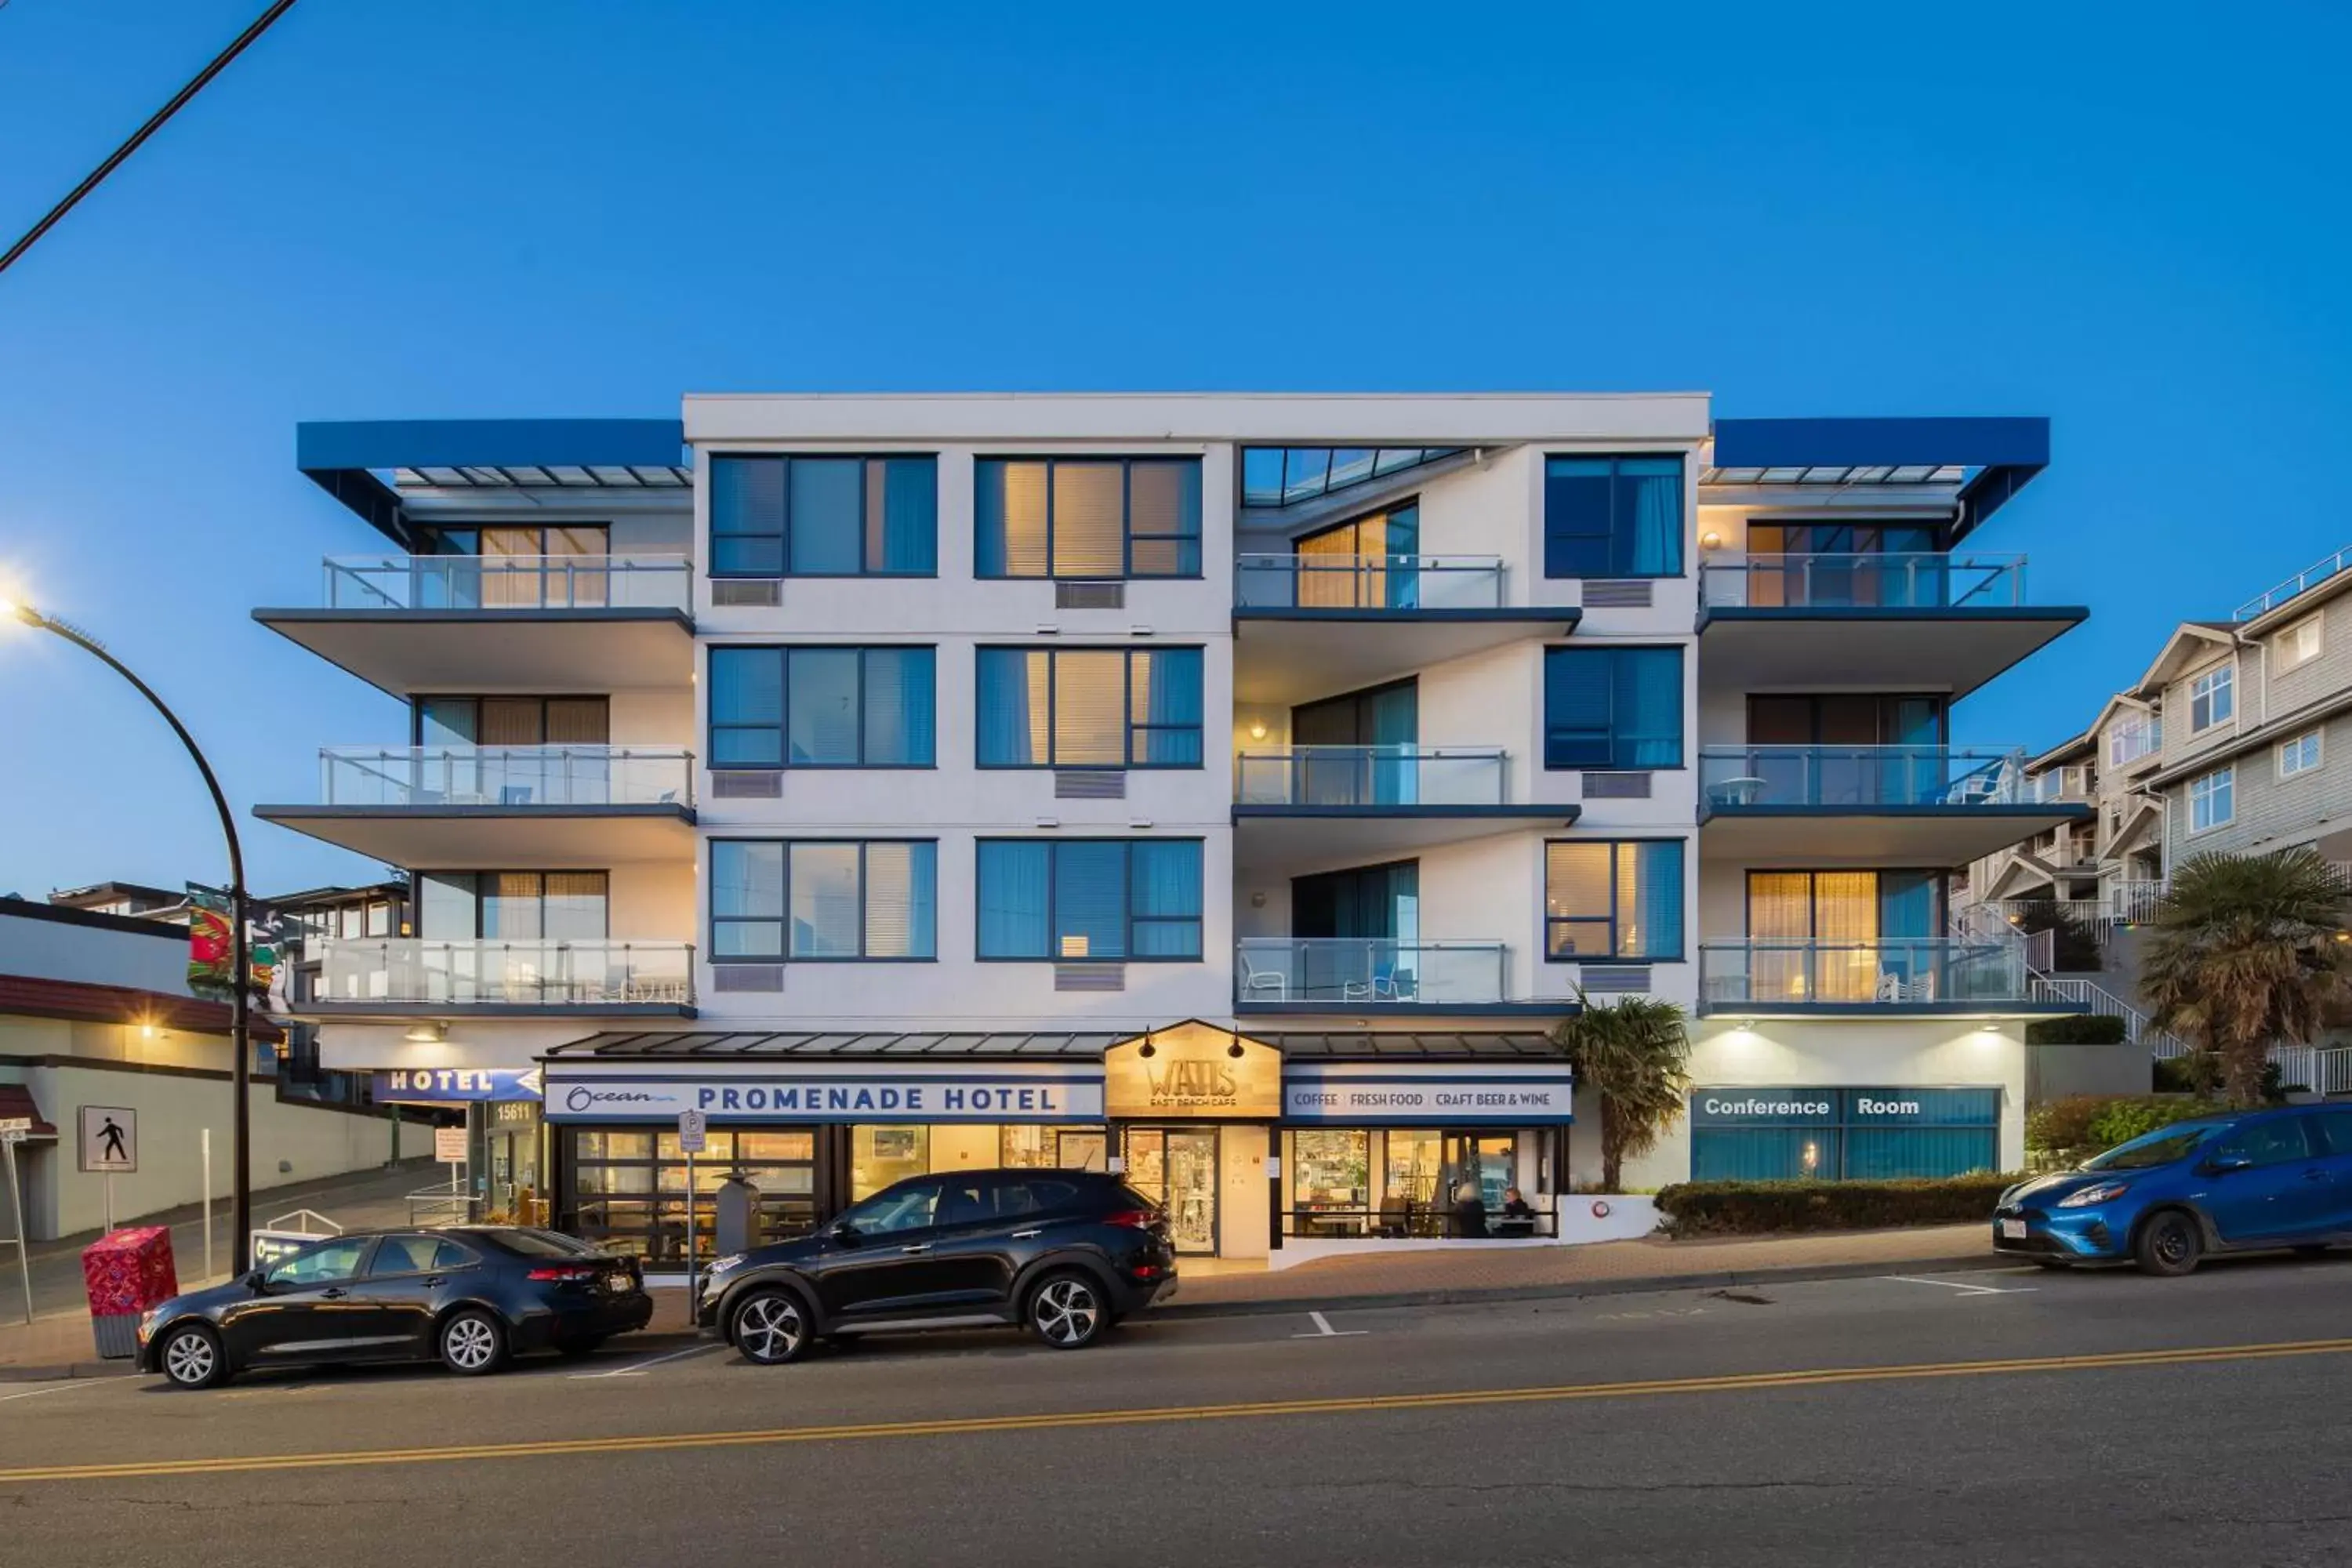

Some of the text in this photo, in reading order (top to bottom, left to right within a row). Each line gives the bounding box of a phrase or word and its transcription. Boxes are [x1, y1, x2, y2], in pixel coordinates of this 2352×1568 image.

[391, 1069, 493, 1091] HOTEL
[566, 1086, 650, 1112] Ocean
[698, 1087, 1056, 1110] PROMENADE HOTEL
[1150, 1098, 1175, 1107] EAST
[1177, 1098, 1209, 1107] BEACH
[1294, 1093, 1551, 1105] COFFEE FRESH FOOD CRAFT BEER & WINE
[1705, 1098, 1919, 1115] Conference Room
[498, 1103, 530, 1120] 15611
